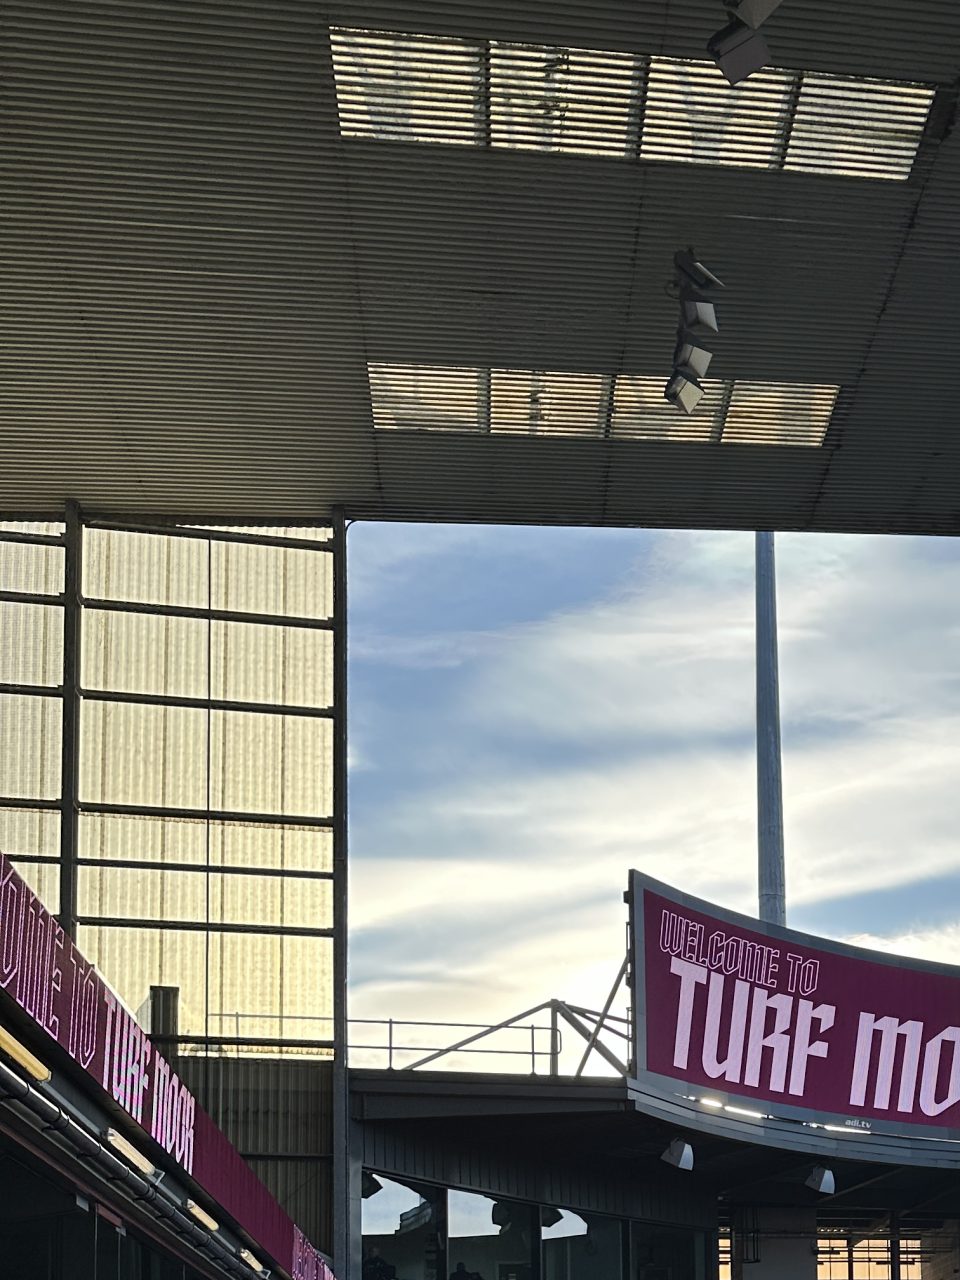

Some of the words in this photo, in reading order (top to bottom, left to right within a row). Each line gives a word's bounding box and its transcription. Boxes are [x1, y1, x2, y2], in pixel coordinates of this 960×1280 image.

[660, 909, 780, 988] WELCOME
[786, 953, 820, 996] TO
[68, 942, 101, 1069] TO
[102, 984, 151, 1126] TURF
[151, 1048, 196, 1176] MOOR
[670, 956, 836, 1096] TURF
[845, 1119, 872, 1129] adi.tv
